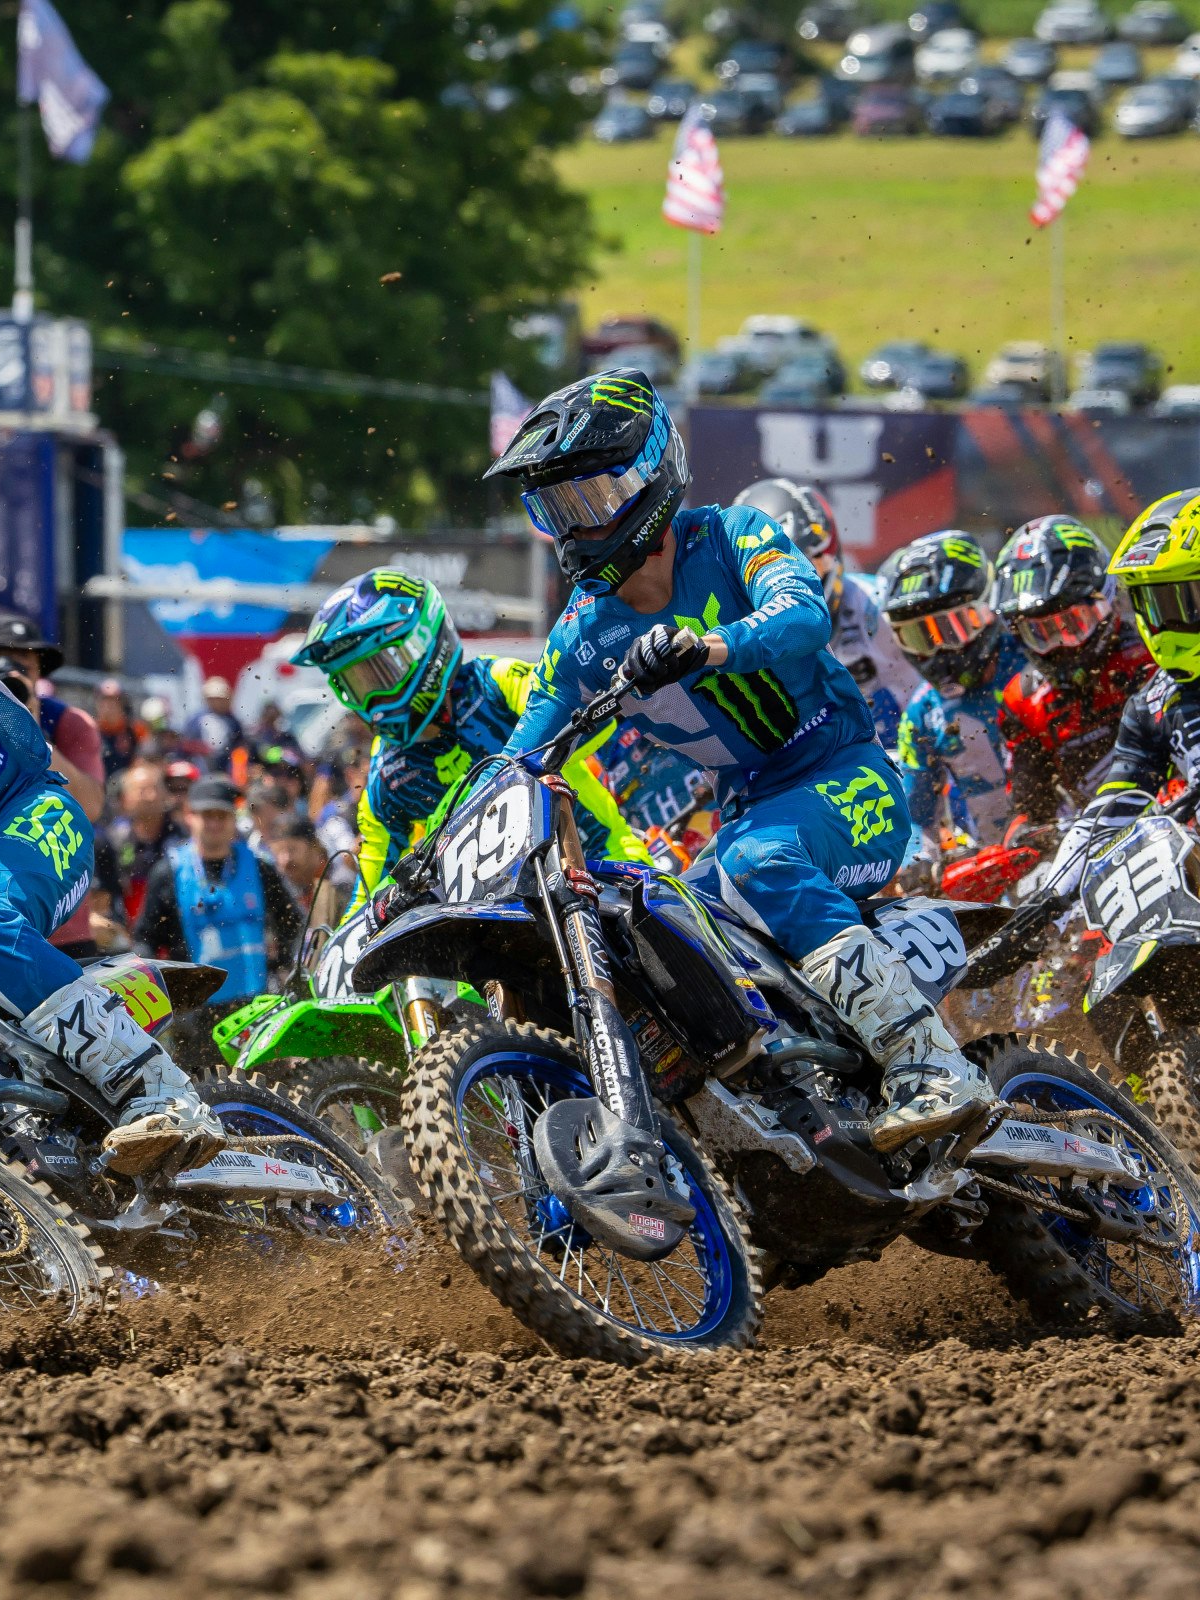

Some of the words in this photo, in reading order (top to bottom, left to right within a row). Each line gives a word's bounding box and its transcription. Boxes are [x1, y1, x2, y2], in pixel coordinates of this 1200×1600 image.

[560, 412, 591, 451] apdesigns
[632, 489, 674, 547] MONSTER
[592, 698, 618, 719] ARC
[444, 785, 530, 902] 59
[850, 859, 892, 887] YAMAHA
[1095, 838, 1181, 944] 33
[58, 869, 90, 920] YAMAHA
[614, 1039, 631, 1077] BRAKING
[1002, 1124, 1055, 1145] YAMALUBE
[44, 1155, 78, 1165] GYTR
[264, 1161, 288, 1176] Kite
